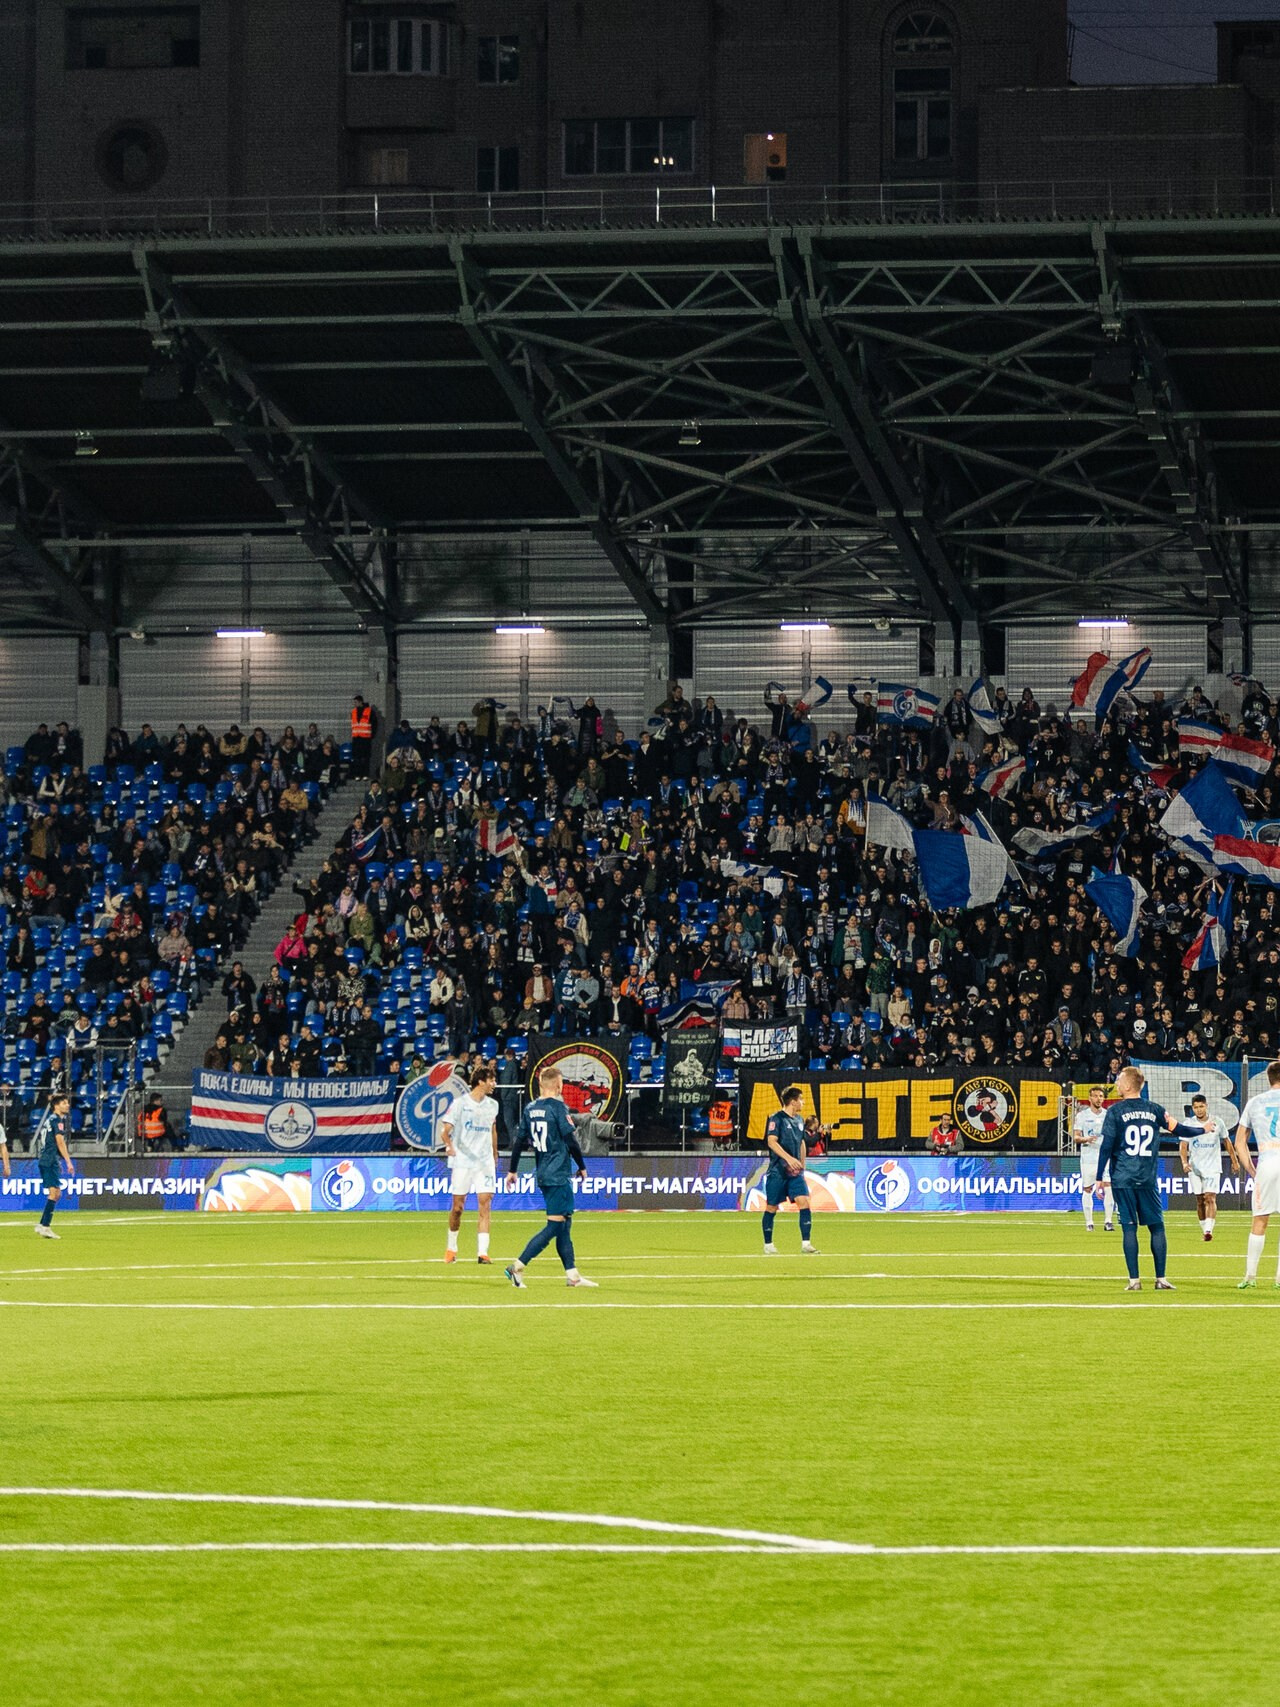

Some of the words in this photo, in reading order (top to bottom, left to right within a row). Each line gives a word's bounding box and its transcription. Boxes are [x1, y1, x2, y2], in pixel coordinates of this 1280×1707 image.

[200, 1072, 228, 1092] ПОКА
[231, 1077, 273, 1097] ЕДИНЫ
[283, 1081, 304, 1099] МЫ
[1265, 1106, 1280, 1138] 7
[1125, 1124, 1154, 1157] 92
[2, 1177, 206, 1196] ИНТРНЕТ-МАГАЗИН
[569, 1177, 747, 1195] ТЕРНЕТ-МАГАЗИН
[917, 1173, 1084, 1196] ОФИЦИАЛЬНЫЙ
